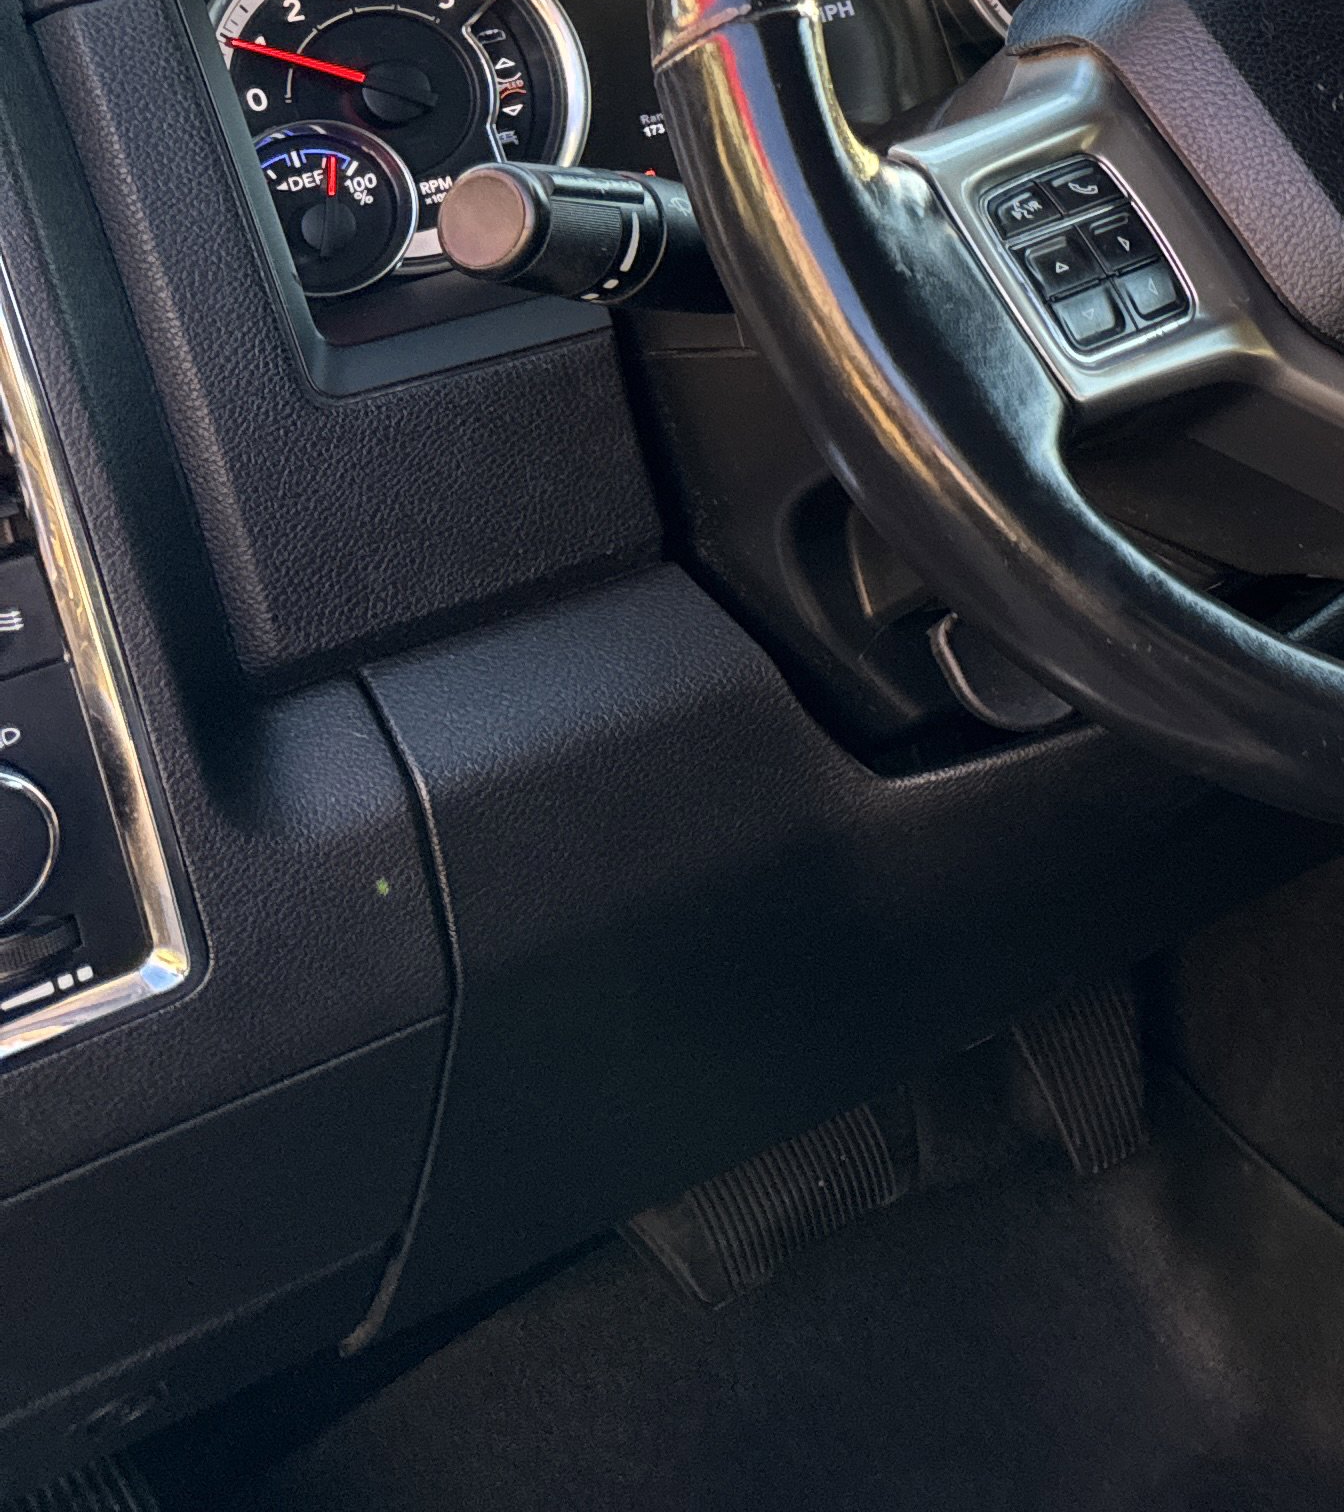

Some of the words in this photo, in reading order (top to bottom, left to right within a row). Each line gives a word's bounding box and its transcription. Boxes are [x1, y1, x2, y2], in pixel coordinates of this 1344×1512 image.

[246, 88, 268, 112] 0
[287, 170, 323, 192] DEF
[419, 175, 453, 195] RPM
